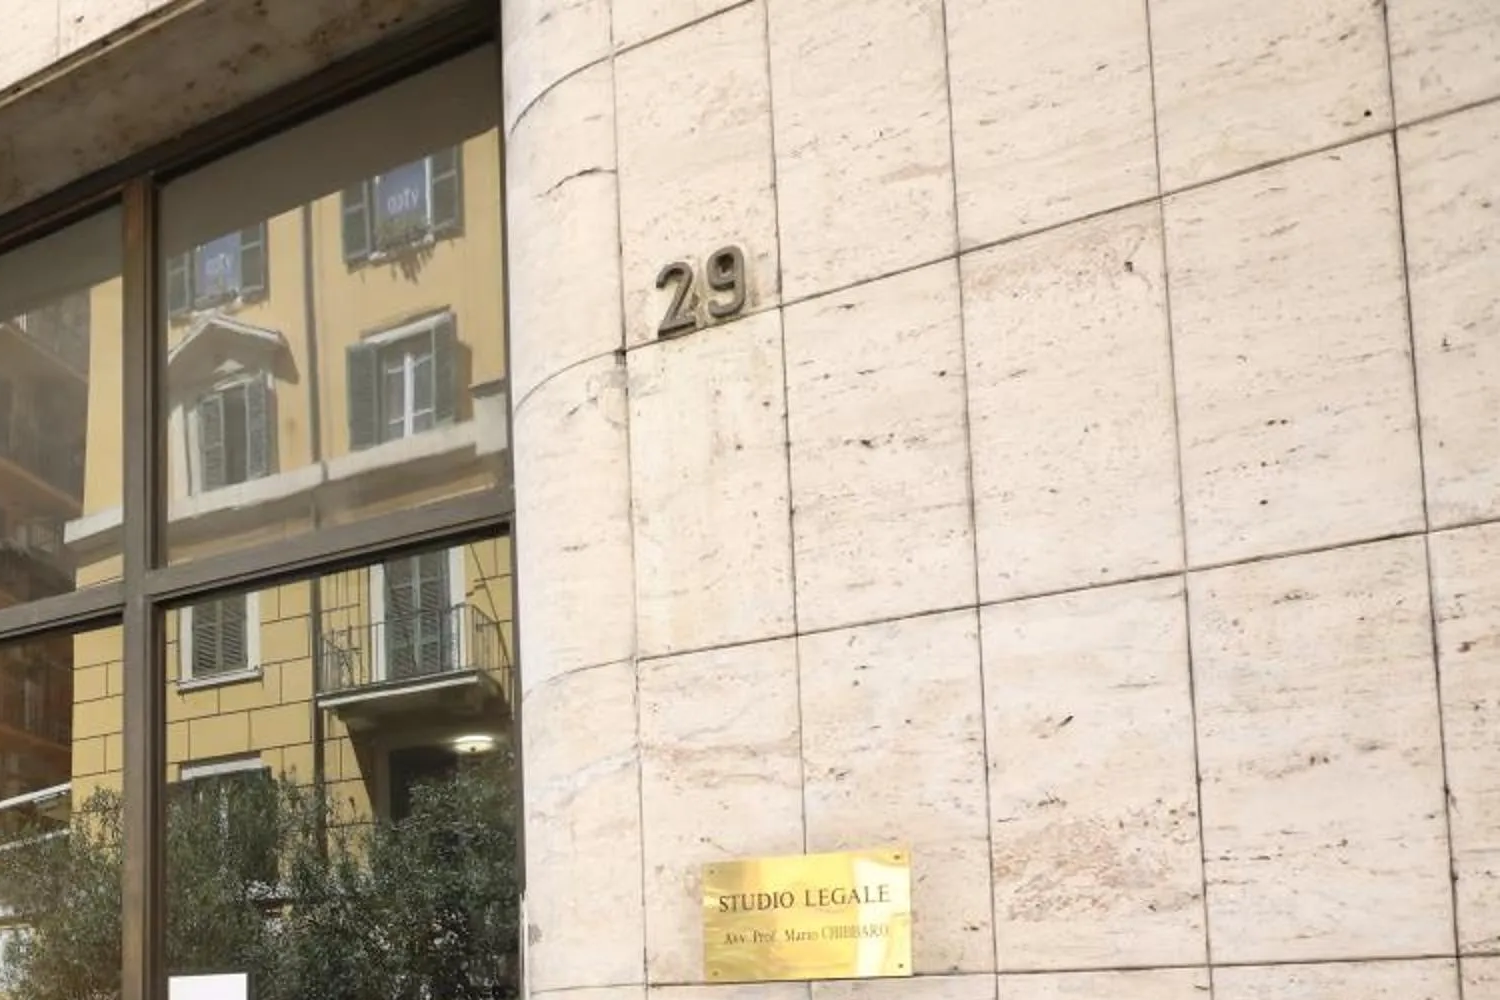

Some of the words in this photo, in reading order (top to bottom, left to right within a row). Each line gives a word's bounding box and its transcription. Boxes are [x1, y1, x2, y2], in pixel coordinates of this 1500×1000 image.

[655, 244, 746, 338] 29
[718, 890, 795, 913] STUDIO
[804, 884, 891, 908] LEGALE
[784, 928, 819, 944] Mario
